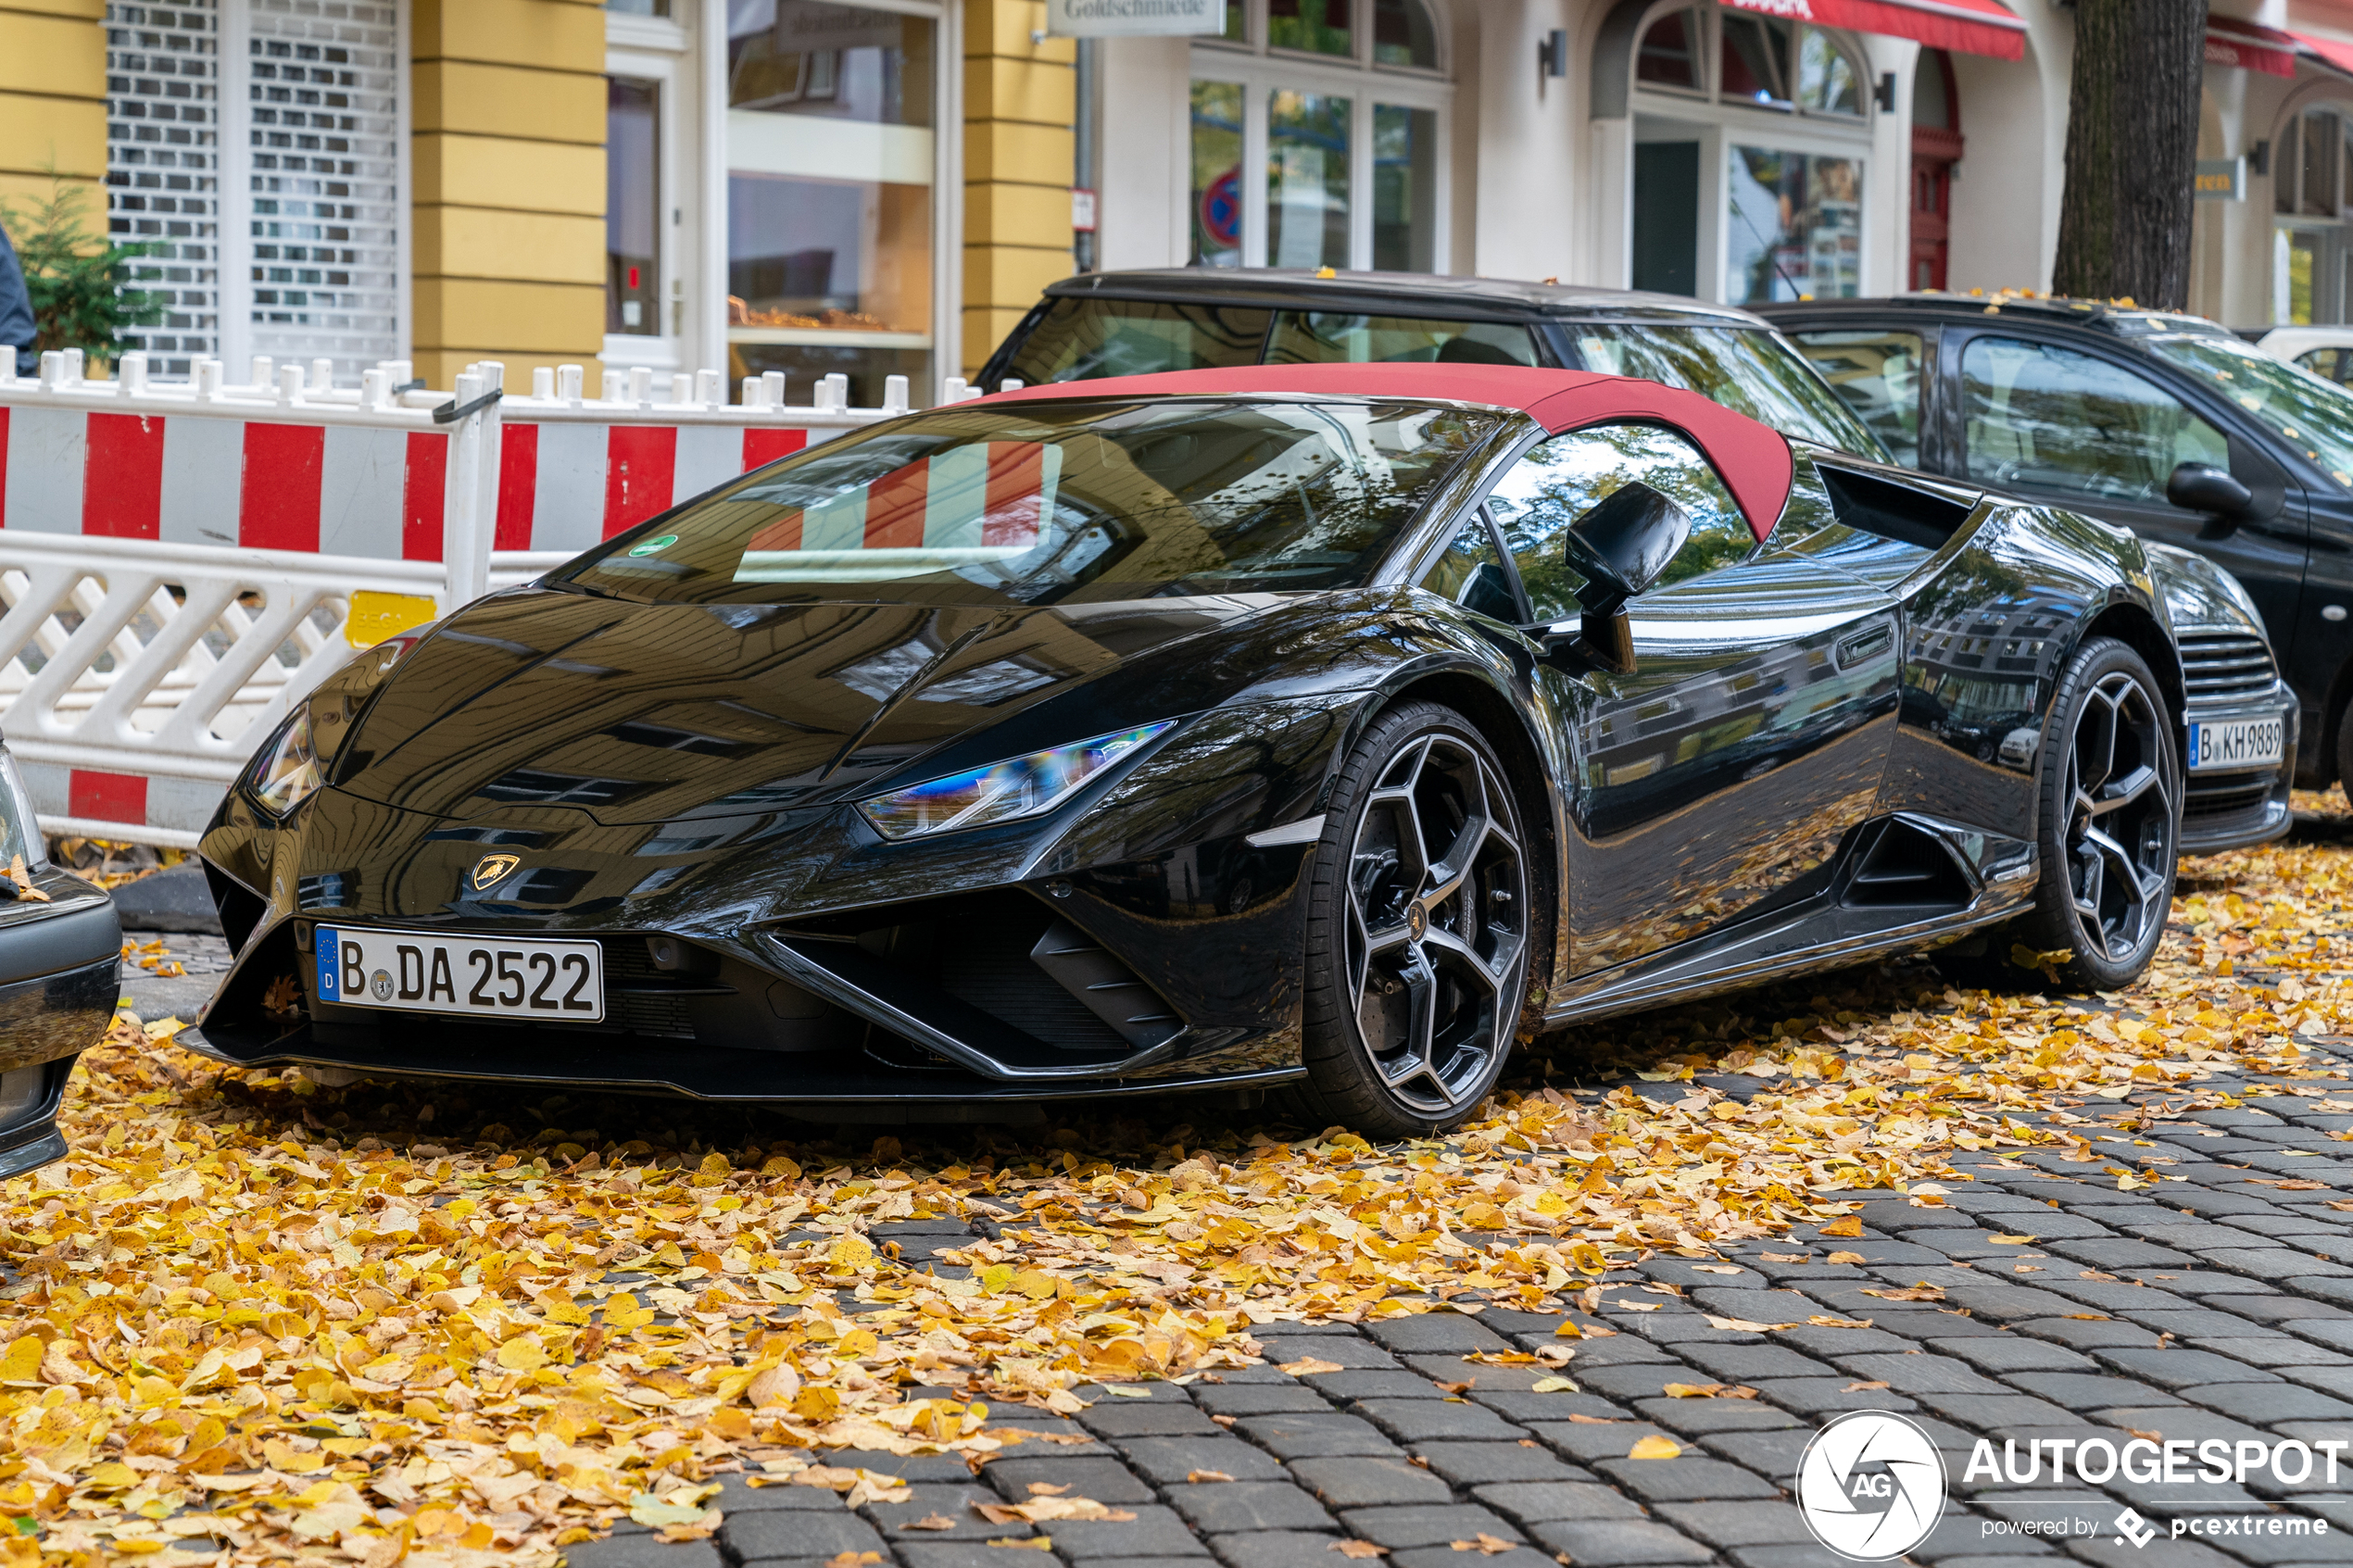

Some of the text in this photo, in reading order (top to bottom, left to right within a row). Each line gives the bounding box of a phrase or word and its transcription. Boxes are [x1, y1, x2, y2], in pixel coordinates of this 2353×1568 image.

[325, 973, 333, 988] D
[341, 940, 366, 995] B
[396, 945, 456, 1002] DA
[468, 948, 593, 1010] 2522
